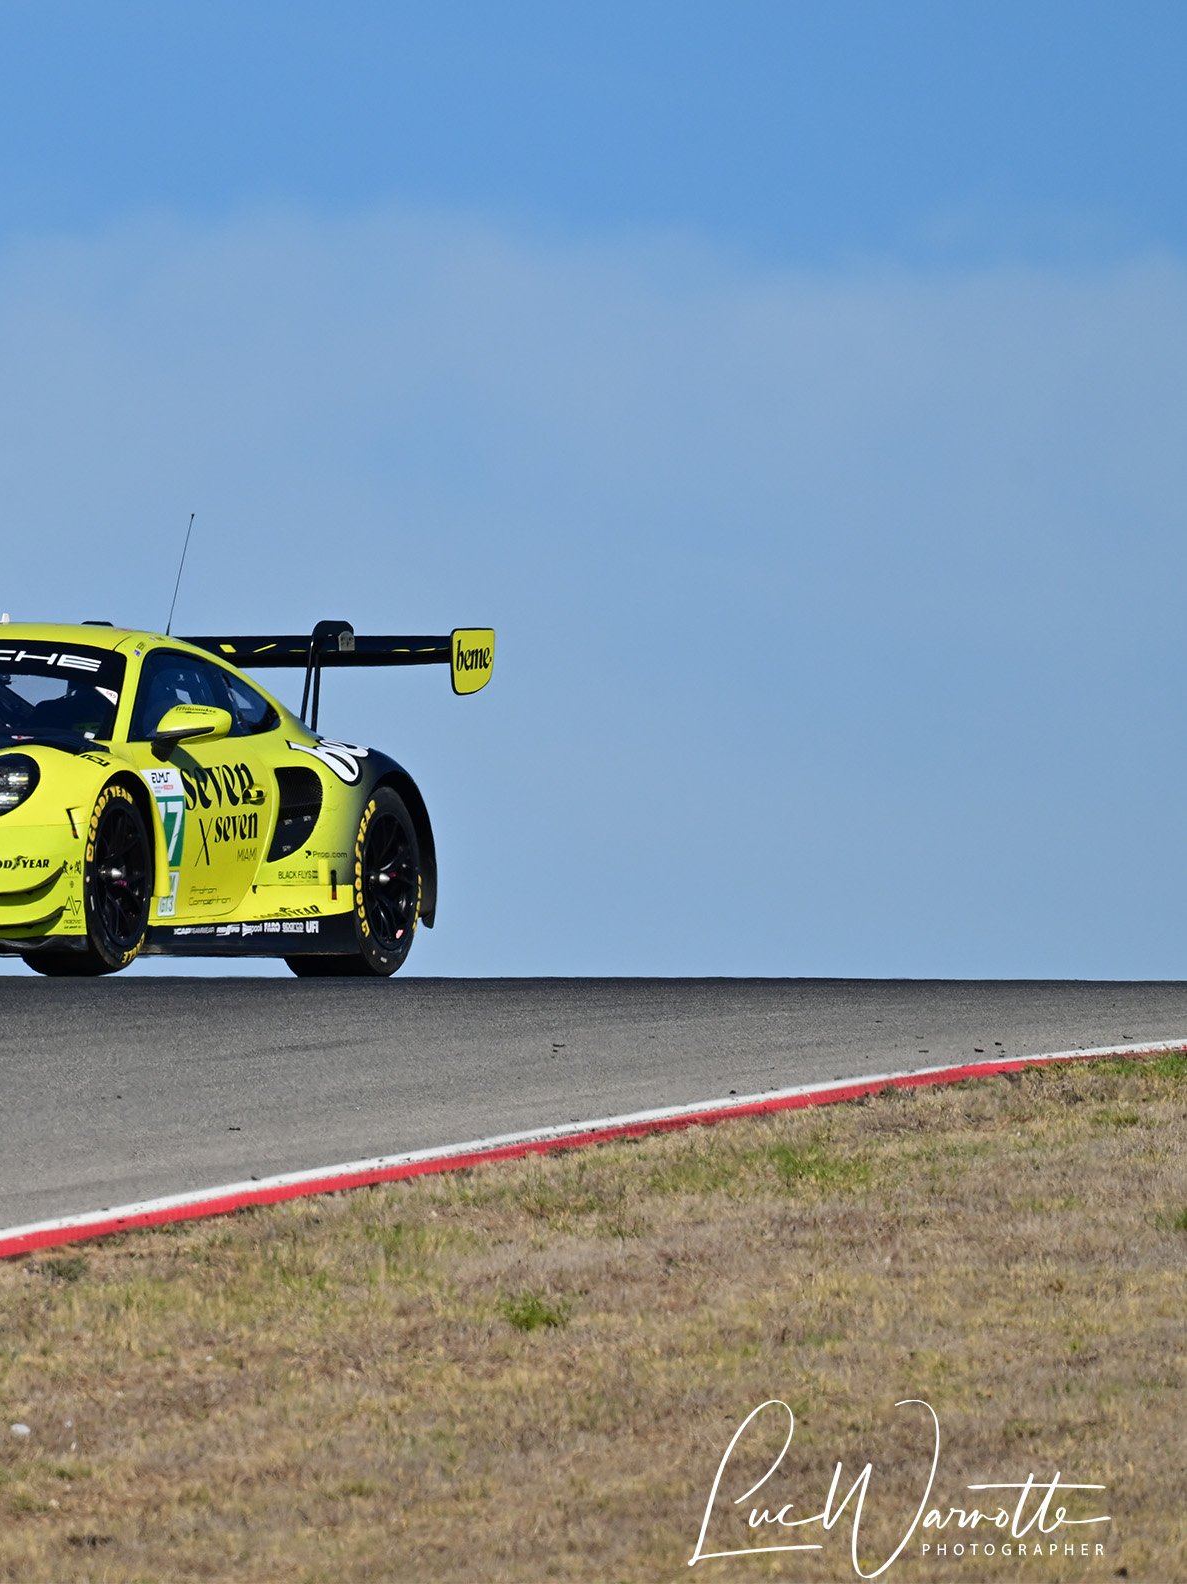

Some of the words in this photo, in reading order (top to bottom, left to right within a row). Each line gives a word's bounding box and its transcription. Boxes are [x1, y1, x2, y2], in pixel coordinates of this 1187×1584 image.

[180, 763, 263, 810] seven
[214, 812, 258, 844] seven
[237, 847, 257, 862] MIAMI
[305, 921, 319, 933] UFI
